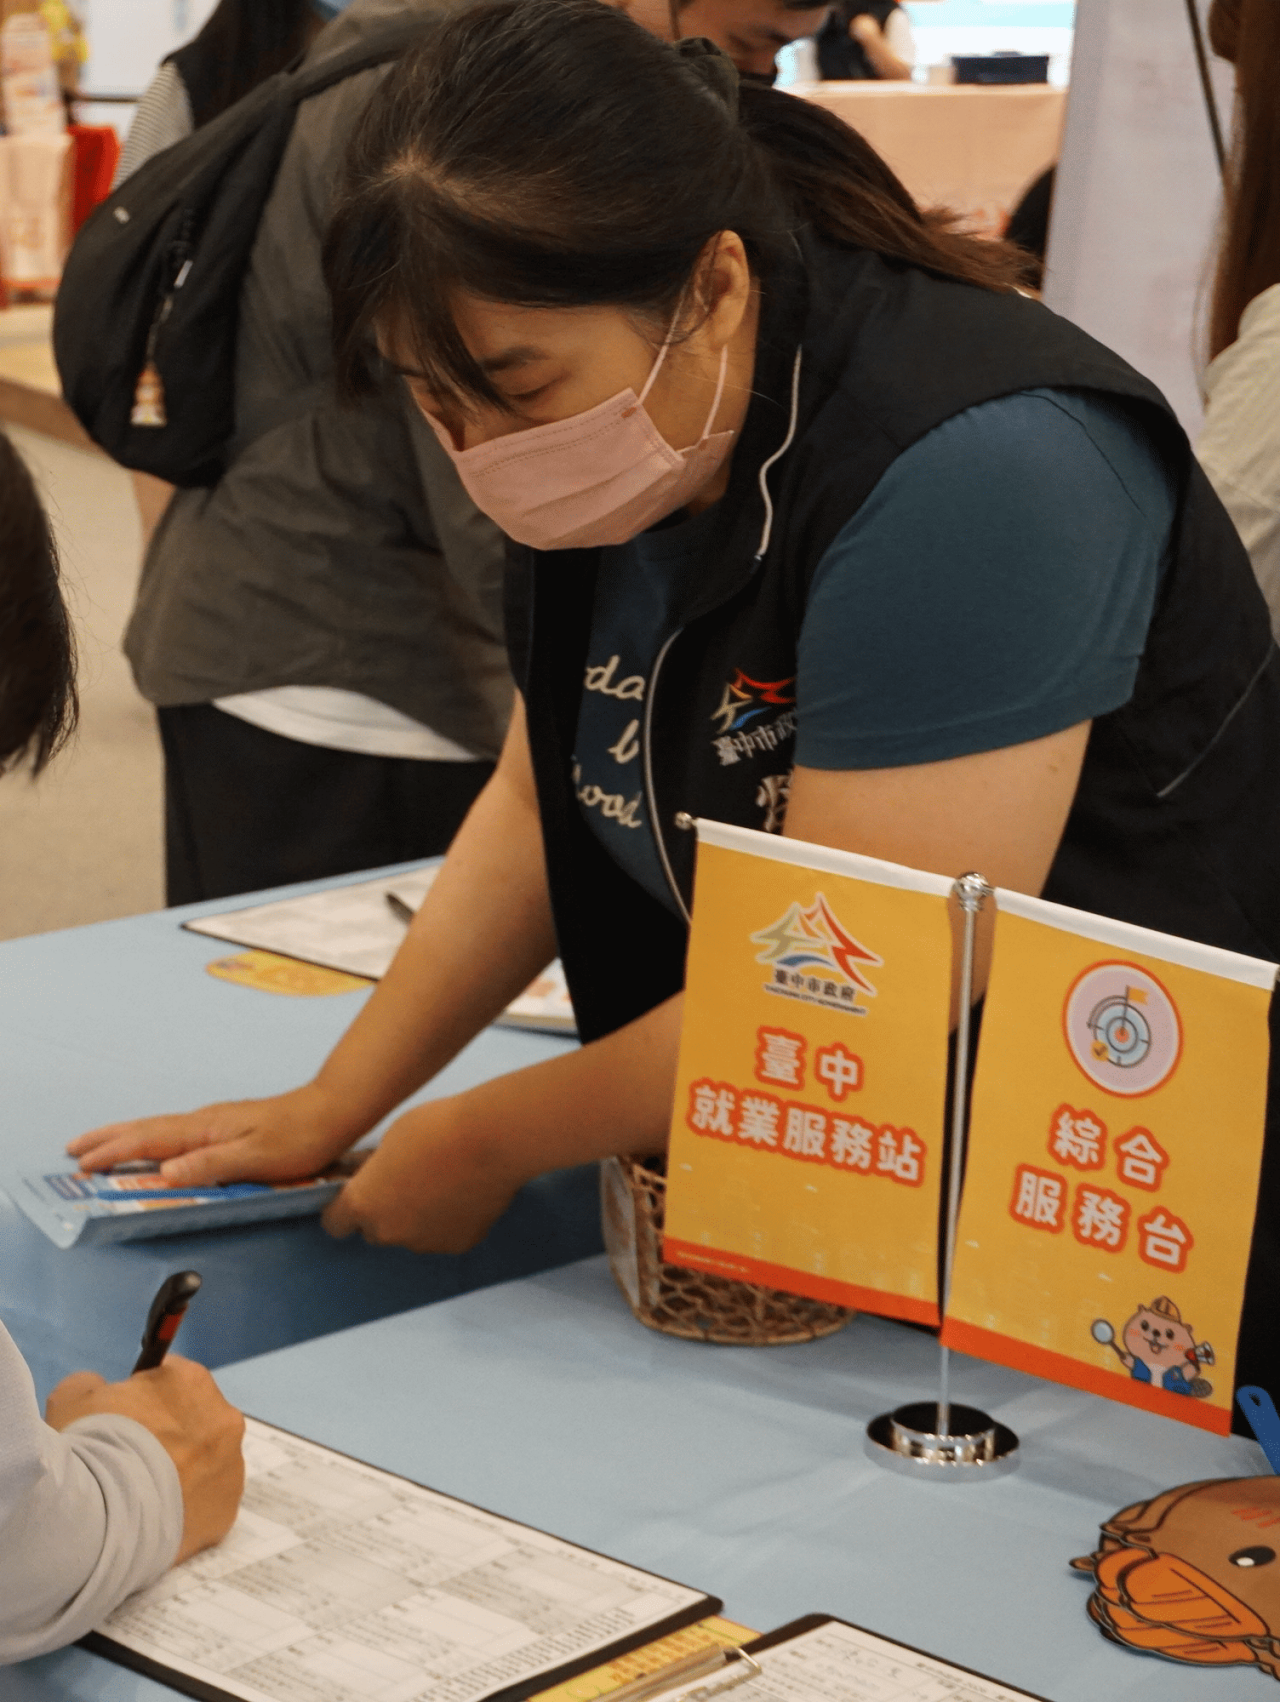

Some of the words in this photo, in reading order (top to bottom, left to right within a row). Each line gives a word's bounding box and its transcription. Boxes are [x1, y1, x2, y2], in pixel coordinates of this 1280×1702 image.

[775, 968, 855, 1003] 臺中市政府
[760, 1030, 859, 1097] 臺中
[692, 1085, 921, 1182] 就業服務站
[1053, 1110, 1163, 1186] 綜合
[1014, 1170, 1189, 1268] 服務台
